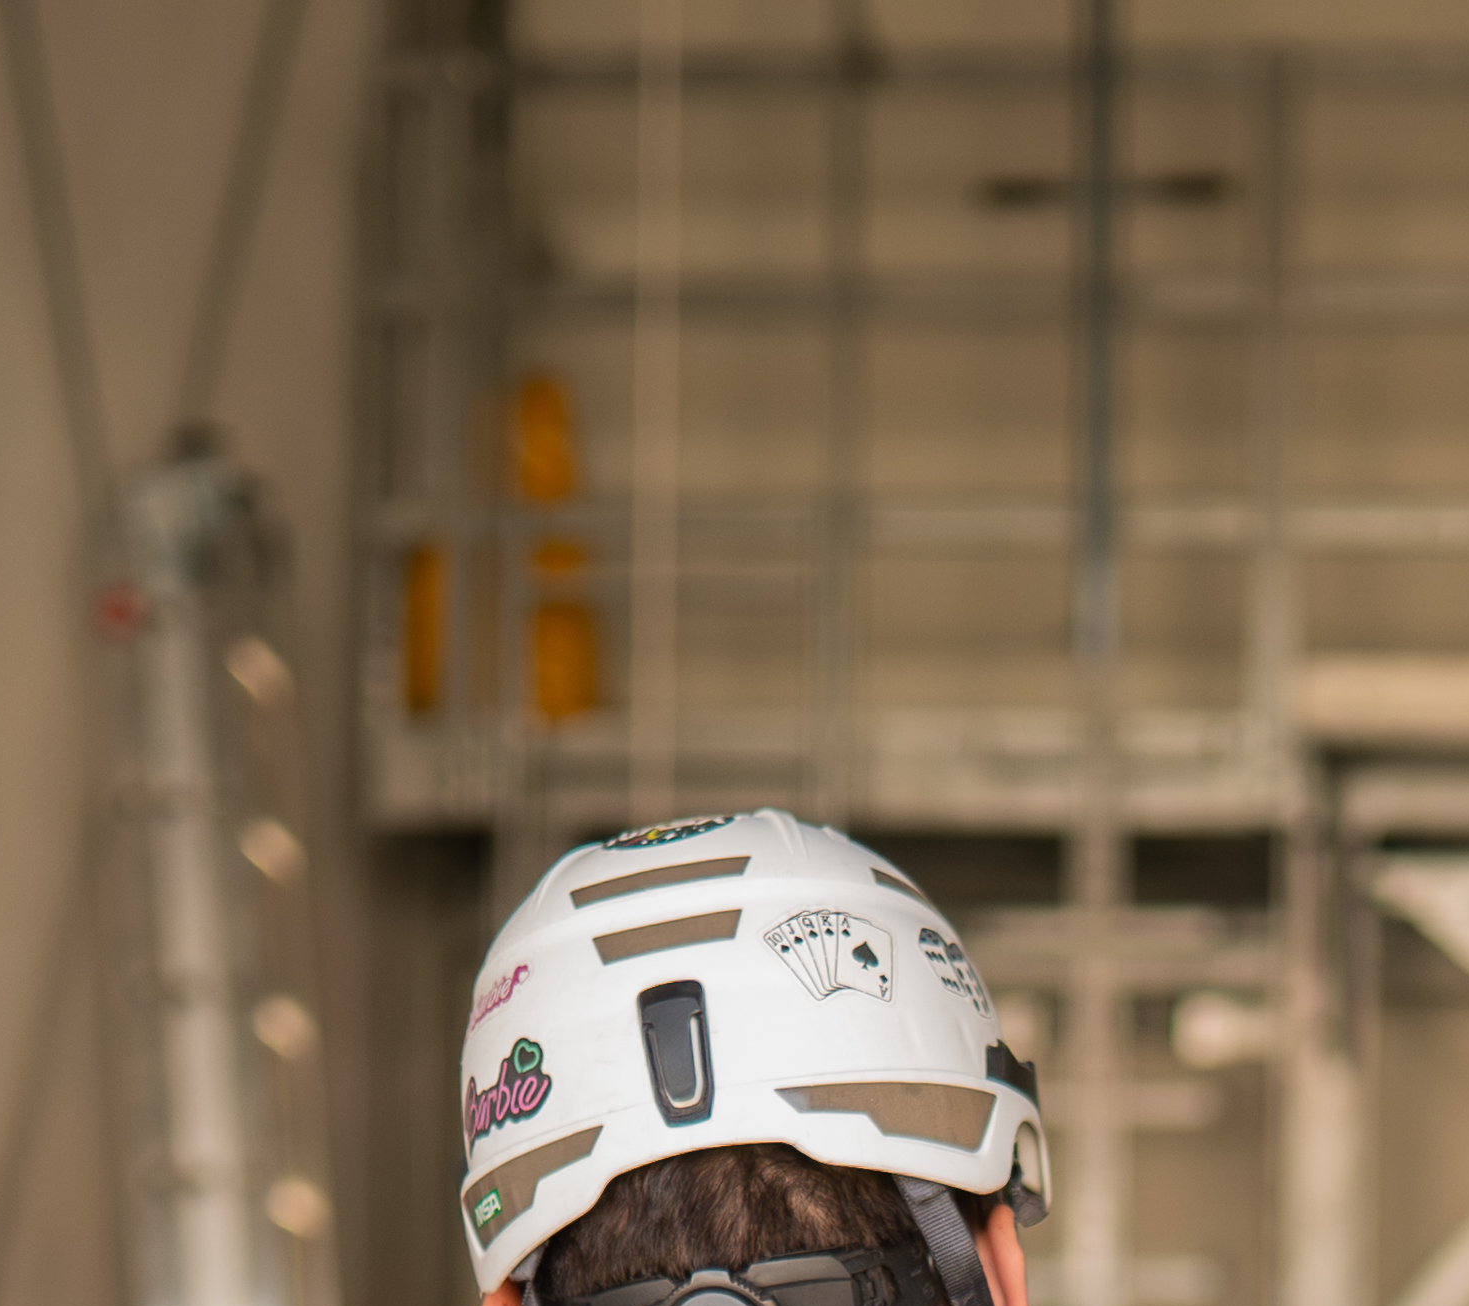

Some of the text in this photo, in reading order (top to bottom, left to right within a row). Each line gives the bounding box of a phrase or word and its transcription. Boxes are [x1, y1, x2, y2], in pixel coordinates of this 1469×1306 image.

[766, 931, 784, 947] 10
[801, 917, 814, 929] Q
[820, 915, 832, 927] K
[474, 1191, 502, 1228] MSA
